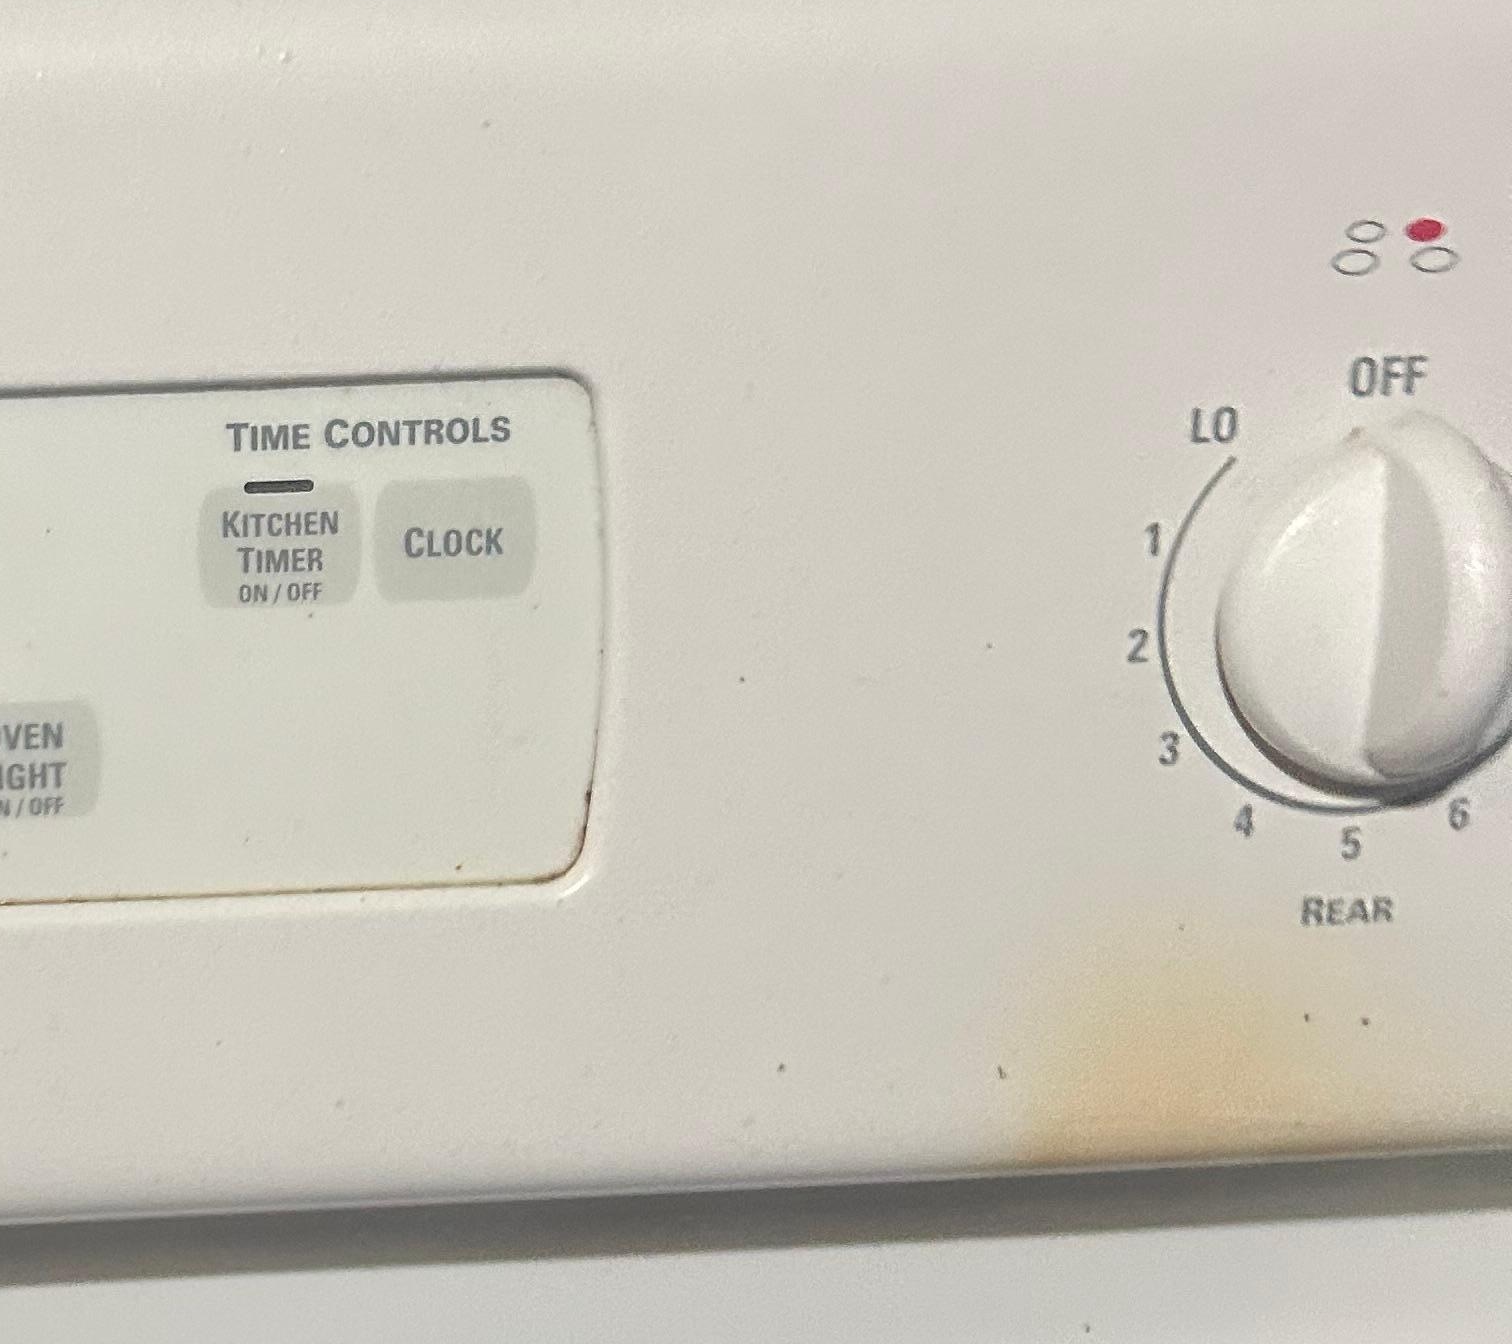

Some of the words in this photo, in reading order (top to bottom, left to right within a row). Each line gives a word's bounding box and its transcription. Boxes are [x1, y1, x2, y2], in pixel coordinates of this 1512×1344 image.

[1349, 355, 1430, 399] OFF
[225, 421, 311, 452] TIME
[324, 416, 512, 450] CONTROLS
[1190, 406, 1241, 445] LO
[221, 508, 340, 539] KITCHEN
[1147, 522, 1163, 557] 1
[403, 525, 505, 558] CLOCK
[236, 545, 325, 575] TIMER
[1126, 627, 1150, 665] 2
[1157, 731, 1181, 767] 3
[1232, 804, 1256, 840] 4
[1448, 797, 1471, 832] 6
[1339, 826, 1364, 860] 5
[1299, 895, 1396, 928] REAR
